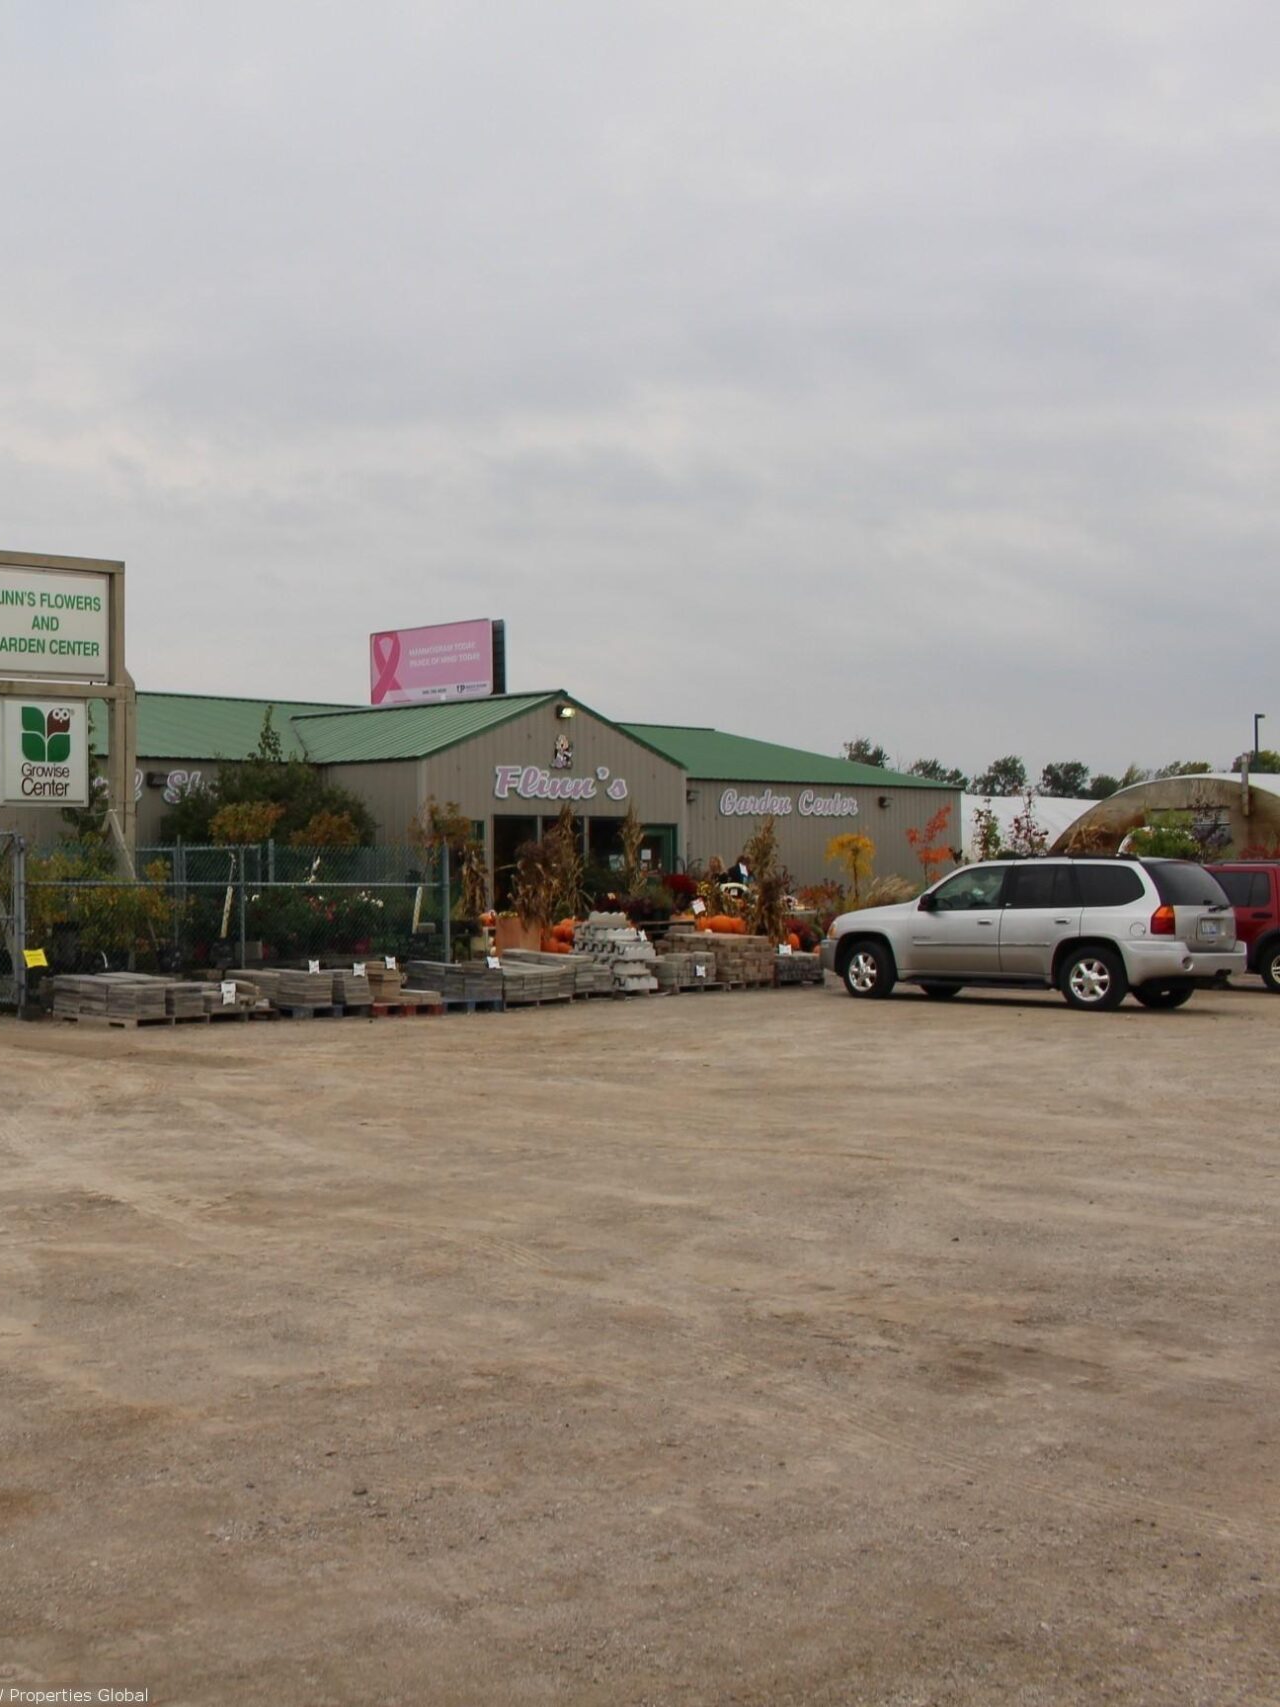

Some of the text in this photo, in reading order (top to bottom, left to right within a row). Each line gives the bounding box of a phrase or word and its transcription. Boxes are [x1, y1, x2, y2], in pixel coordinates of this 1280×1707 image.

[40, 593, 102, 612] FLOWERS
[31, 615, 60, 631] AND
[49, 640, 100, 656] CENTER
[21, 762, 70, 778] Growise
[21, 777, 70, 796] Center
[495, 766, 628, 800] Flinn's
[720, 788, 858, 815] Garden Center
